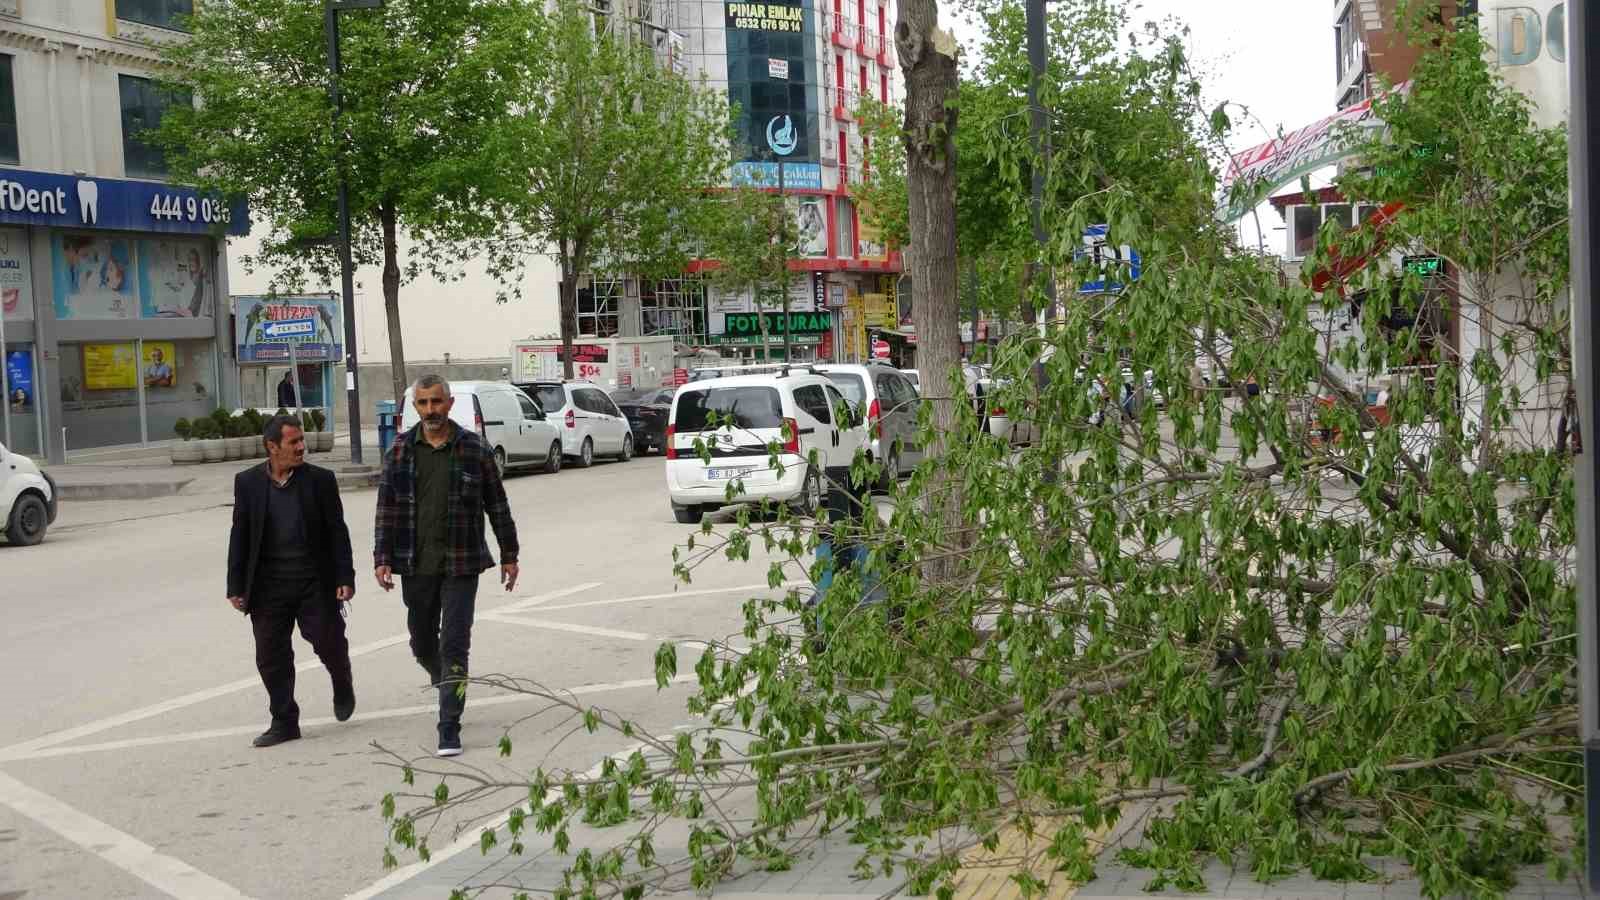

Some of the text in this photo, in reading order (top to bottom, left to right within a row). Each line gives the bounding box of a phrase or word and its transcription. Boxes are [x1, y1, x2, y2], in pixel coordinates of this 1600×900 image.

[728, 3, 803, 21] PINAR EMLAK
[735, 18, 801, 32] 0532 676 90 14
[151, 193, 182, 220] 444
[186, 197, 197, 221] 9
